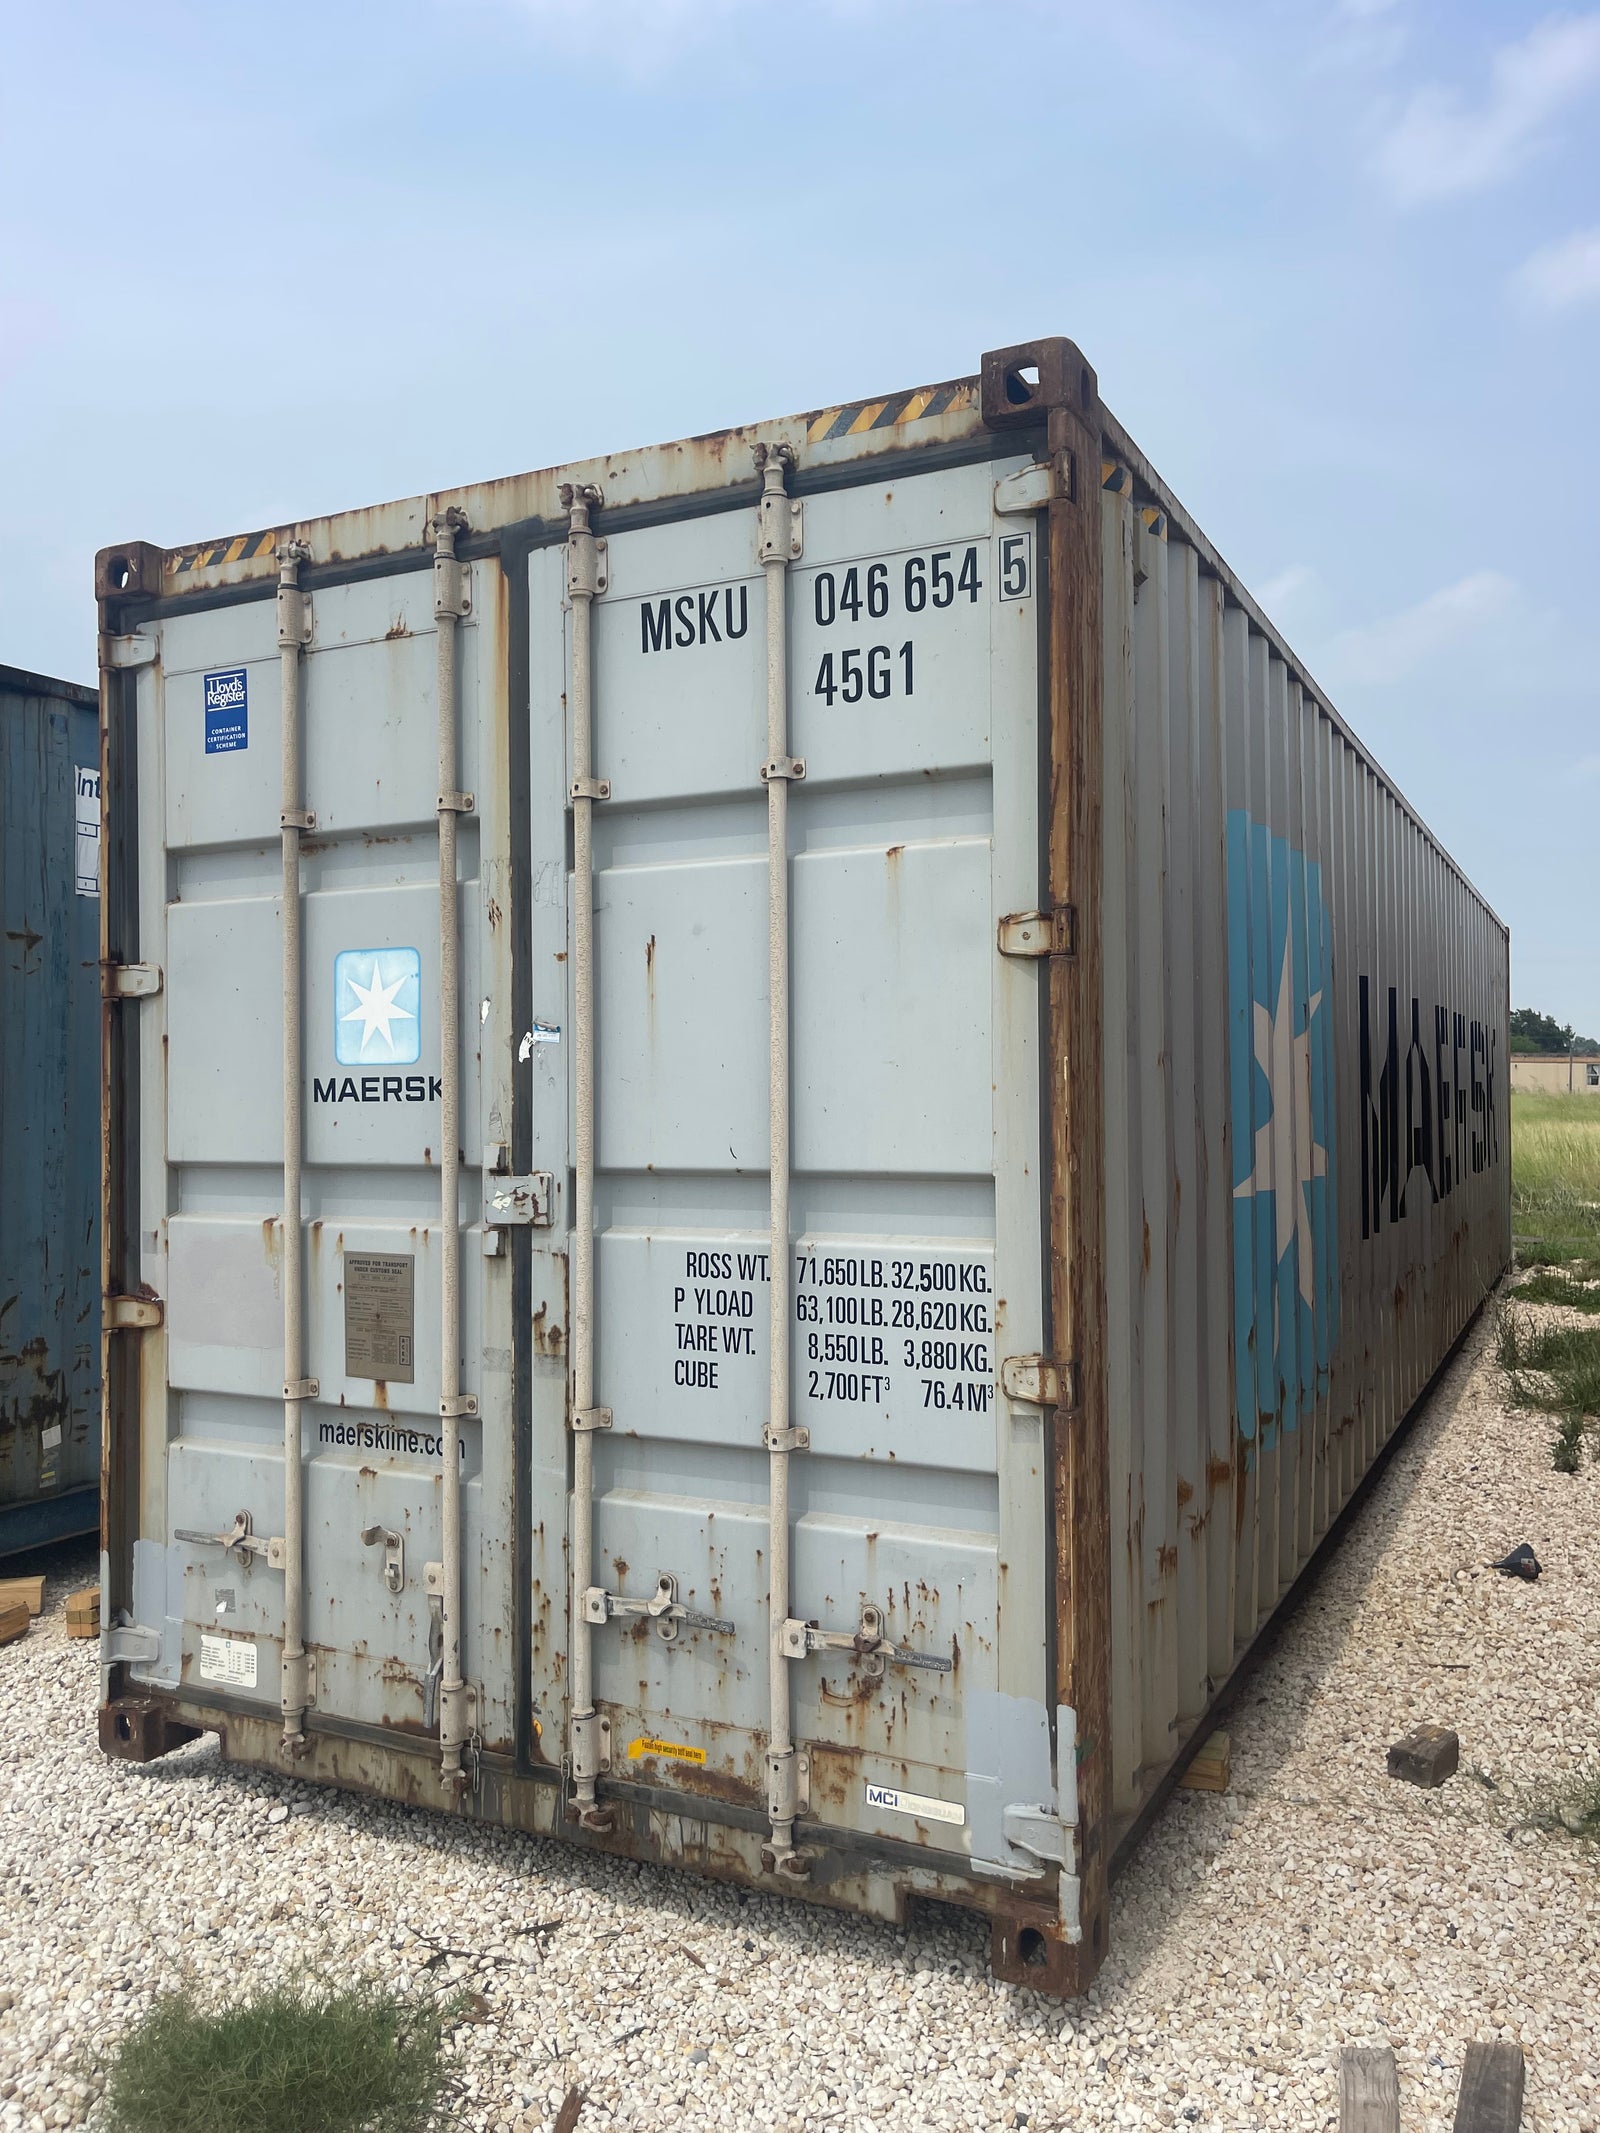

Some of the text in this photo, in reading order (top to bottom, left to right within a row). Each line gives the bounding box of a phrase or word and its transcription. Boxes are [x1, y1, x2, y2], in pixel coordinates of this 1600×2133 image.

[641, 537, 1028, 654] MSKU 046 654 5
[814, 640, 914, 707] 45G1
[207, 690, 245, 707] Register
[207, 732, 246, 743] CERTIFICATION
[211, 725, 242, 735] CONTAINER
[215, 741, 237, 749] SCHEME
[313, 1076, 442, 1102] MAERSK
[686, 1251, 732, 1280] ROSS
[737, 1255, 771, 1282] WT.
[675, 1323, 718, 1351] TARE
[721, 1327, 756, 1355] WT.
[674, 1359, 719, 1389] CUBE
[663, 1745, 677, 1756] security
[869, 1789, 898, 1806] MCI
